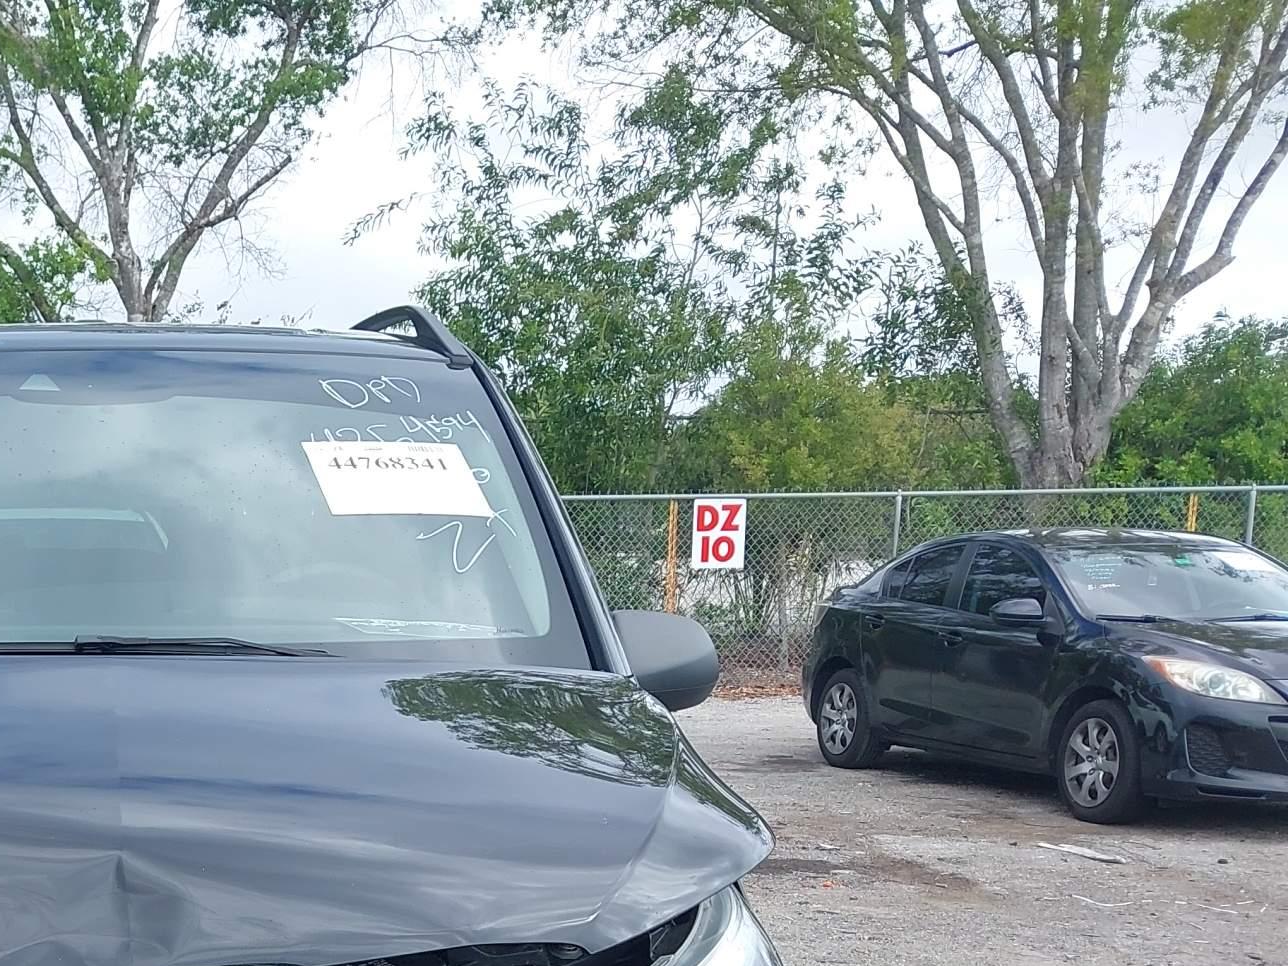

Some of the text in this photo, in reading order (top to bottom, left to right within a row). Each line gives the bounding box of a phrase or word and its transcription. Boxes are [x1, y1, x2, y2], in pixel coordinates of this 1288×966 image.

[328, 456, 448, 471] 44768341
[697, 504, 742, 532] DZ
[700, 535, 735, 562] 10
